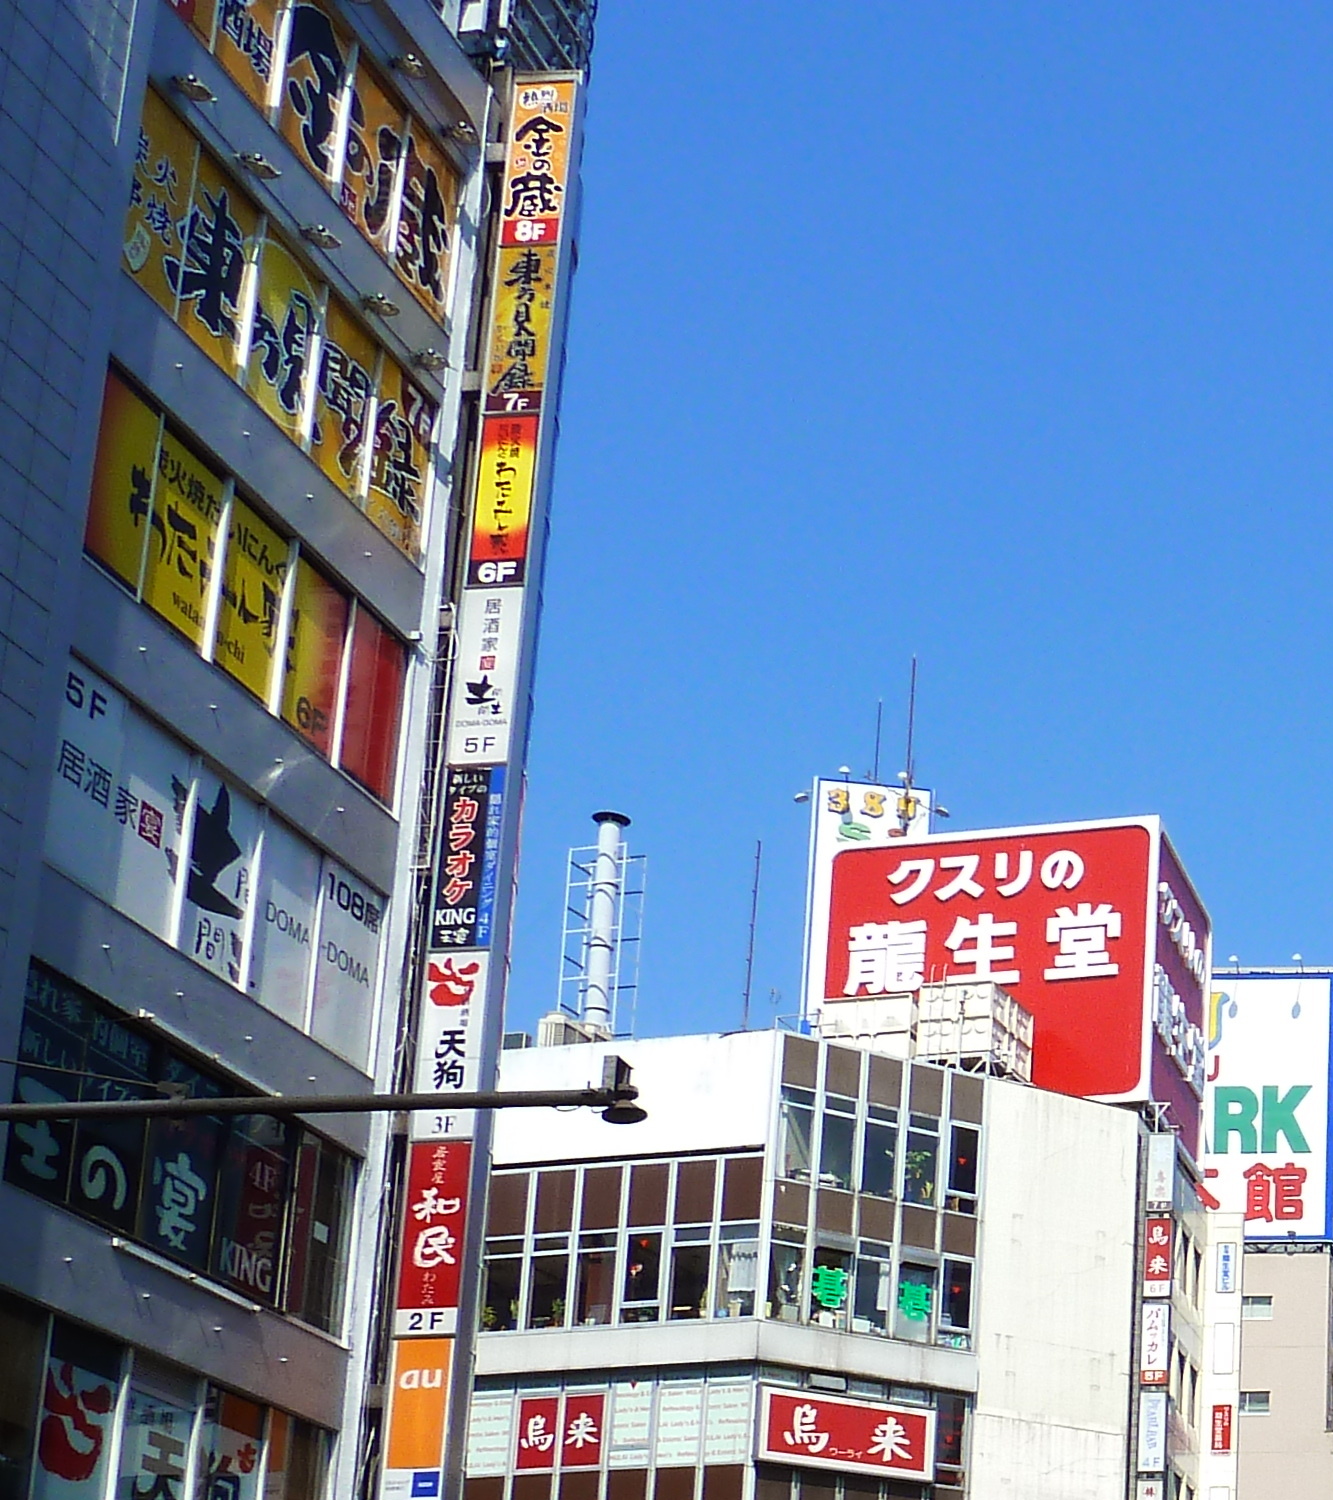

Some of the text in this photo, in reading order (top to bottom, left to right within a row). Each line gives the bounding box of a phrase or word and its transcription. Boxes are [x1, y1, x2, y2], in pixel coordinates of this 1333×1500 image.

[504, 116, 563, 218] 金の蔵
[515, 221, 546, 242] 8F
[491, 249, 542, 394] 東方見聞録
[503, 393, 530, 411] 7F
[478, 562, 517, 583] 6F
[65, 671, 108, 720] 5F
[464, 737, 496, 754] 5F
[442, 796, 479, 906] カラオケ
[887, 849, 1086, 906] クスリの
[435, 908, 476, 927] KING
[843, 902, 1122, 997] 龍生堂
[434, 1029, 466, 1091] 天狗
[432, 1115, 459, 1134] 3F
[412, 1187, 462, 1269] 和民
[421, 1271, 437, 1305] わたみ
[408, 1312, 445, 1331] 2F
[400, 1366, 441, 1390] au
